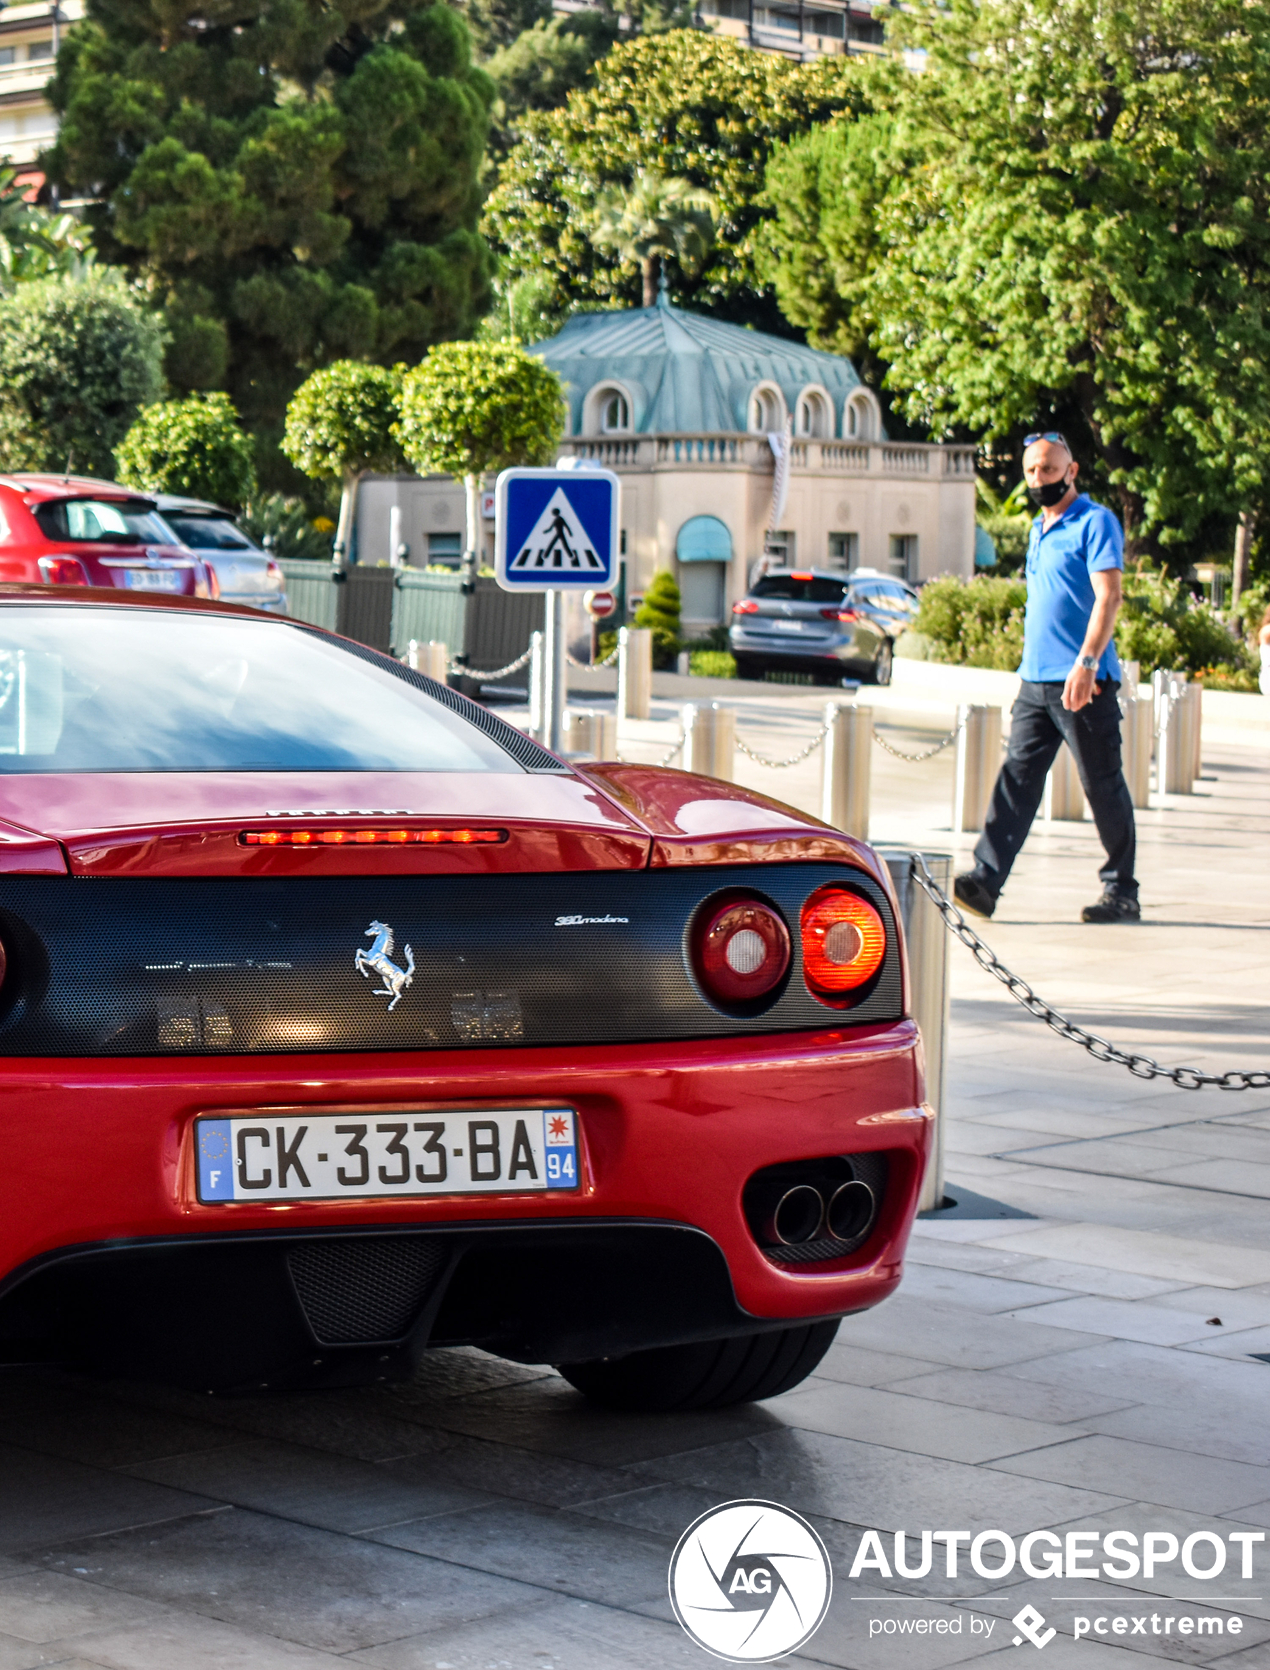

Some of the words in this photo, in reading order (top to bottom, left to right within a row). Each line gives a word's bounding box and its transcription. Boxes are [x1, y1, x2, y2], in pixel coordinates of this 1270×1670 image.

[237, 1119, 538, 1189] CK-333-BA
[547, 1153, 575, 1178] 94
[210, 1170, 221, 1188] F
